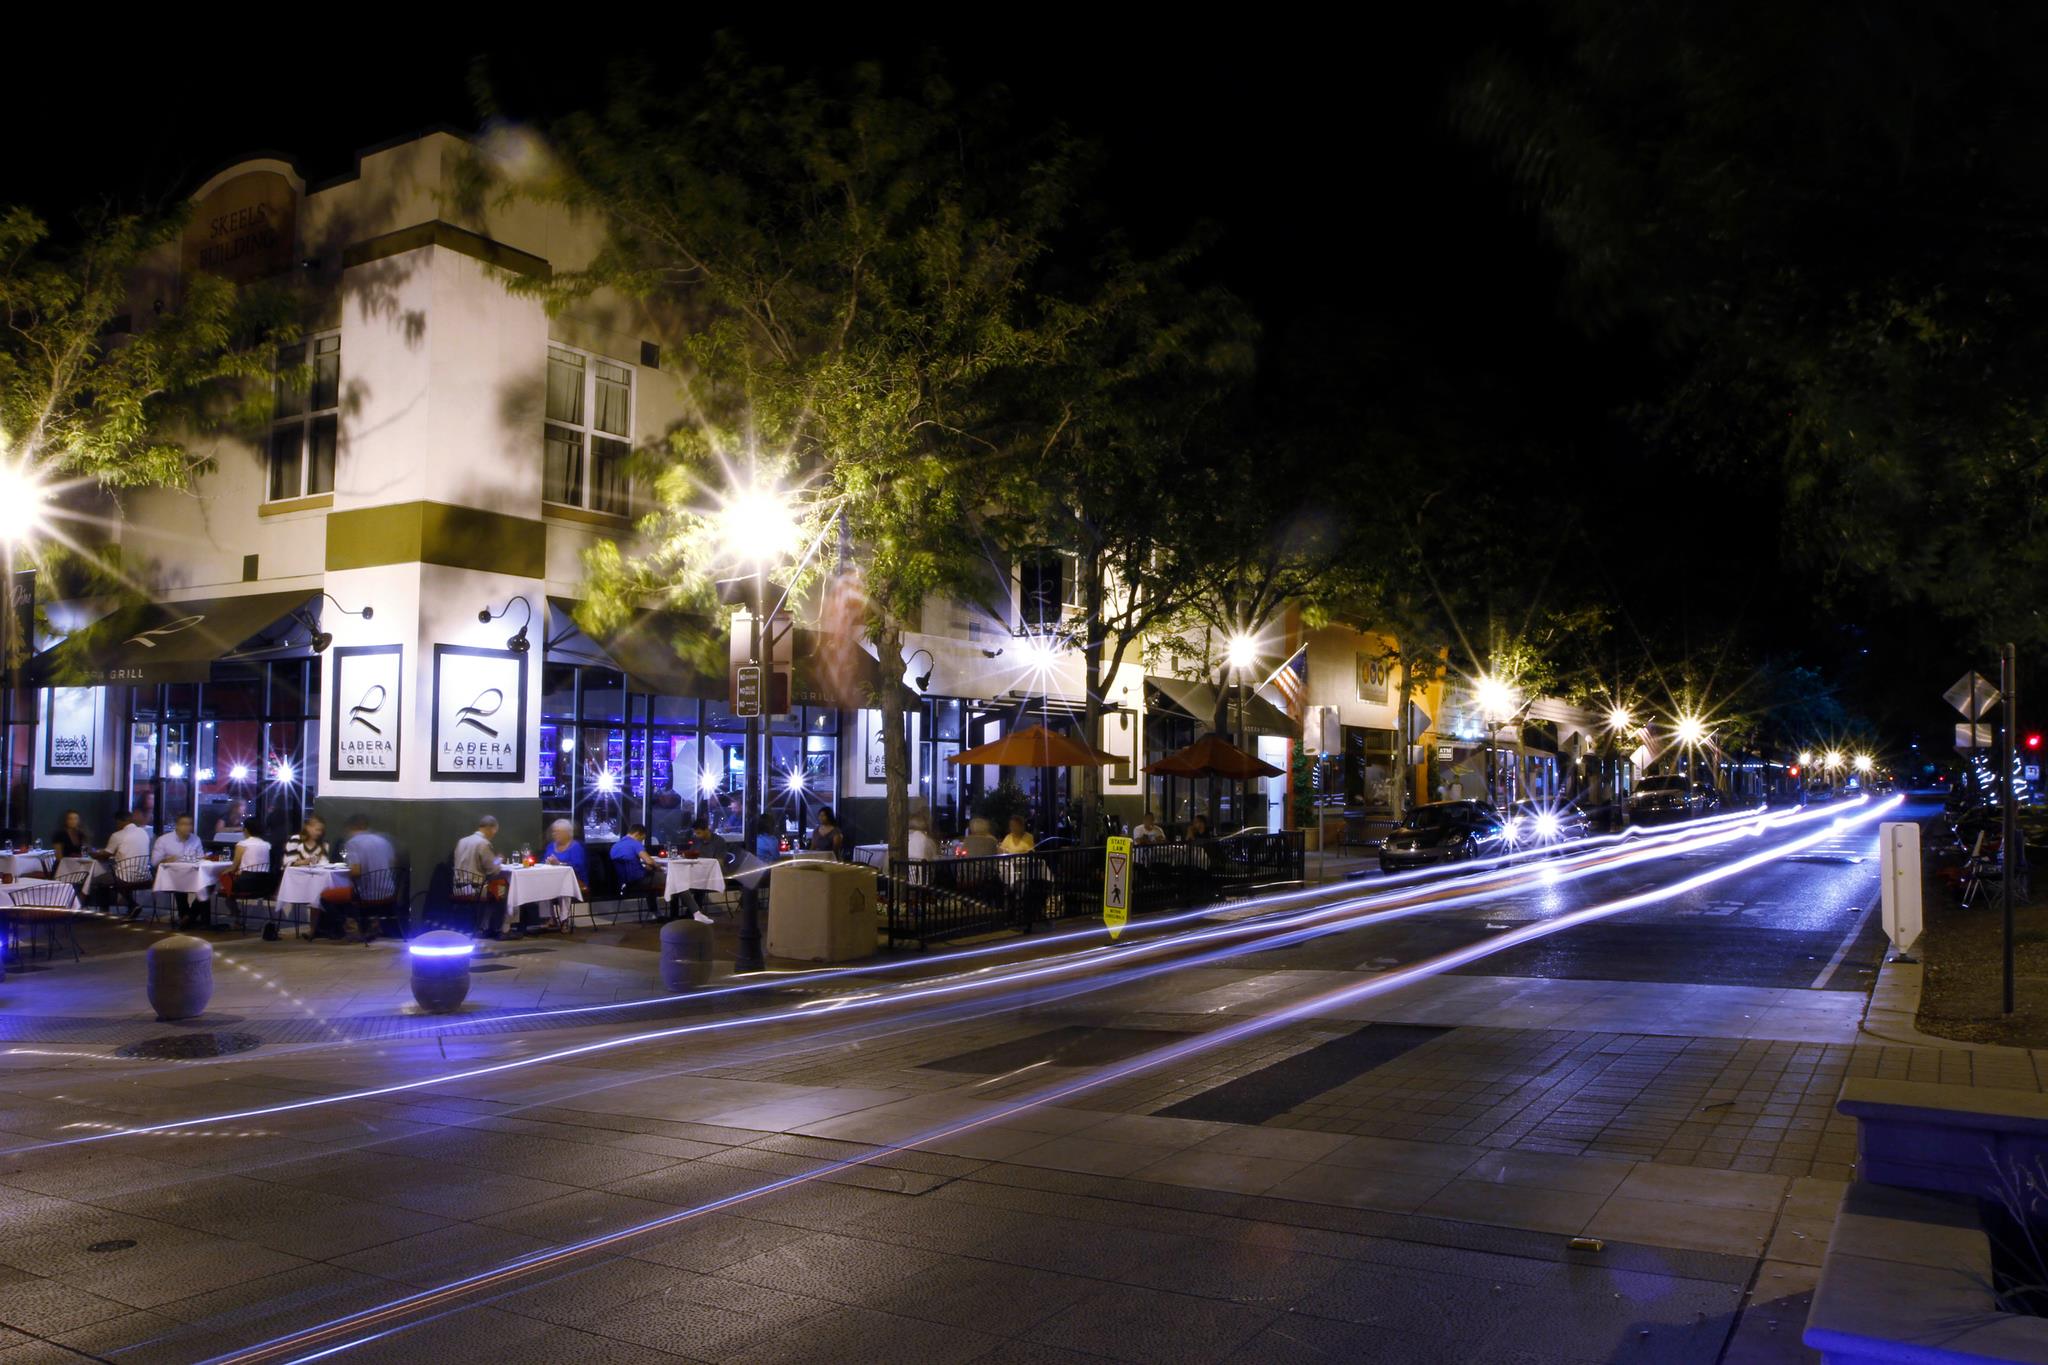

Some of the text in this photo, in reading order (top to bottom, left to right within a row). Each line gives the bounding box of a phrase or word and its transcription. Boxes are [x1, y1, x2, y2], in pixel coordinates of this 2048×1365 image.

[210, 202, 266, 240] SKEELS
[110, 668, 144, 680] GRILL
[800, 690, 836, 702] GRILL
[56, 735, 79, 750] steak
[341, 741, 392, 751] LADERA
[444, 742, 512, 754] LADERA
[55, 751, 89, 765] seafood
[347, 755, 385, 766] GRILL
[454, 756, 504, 768] GRILL
[1111, 838, 1126, 846] STATE
